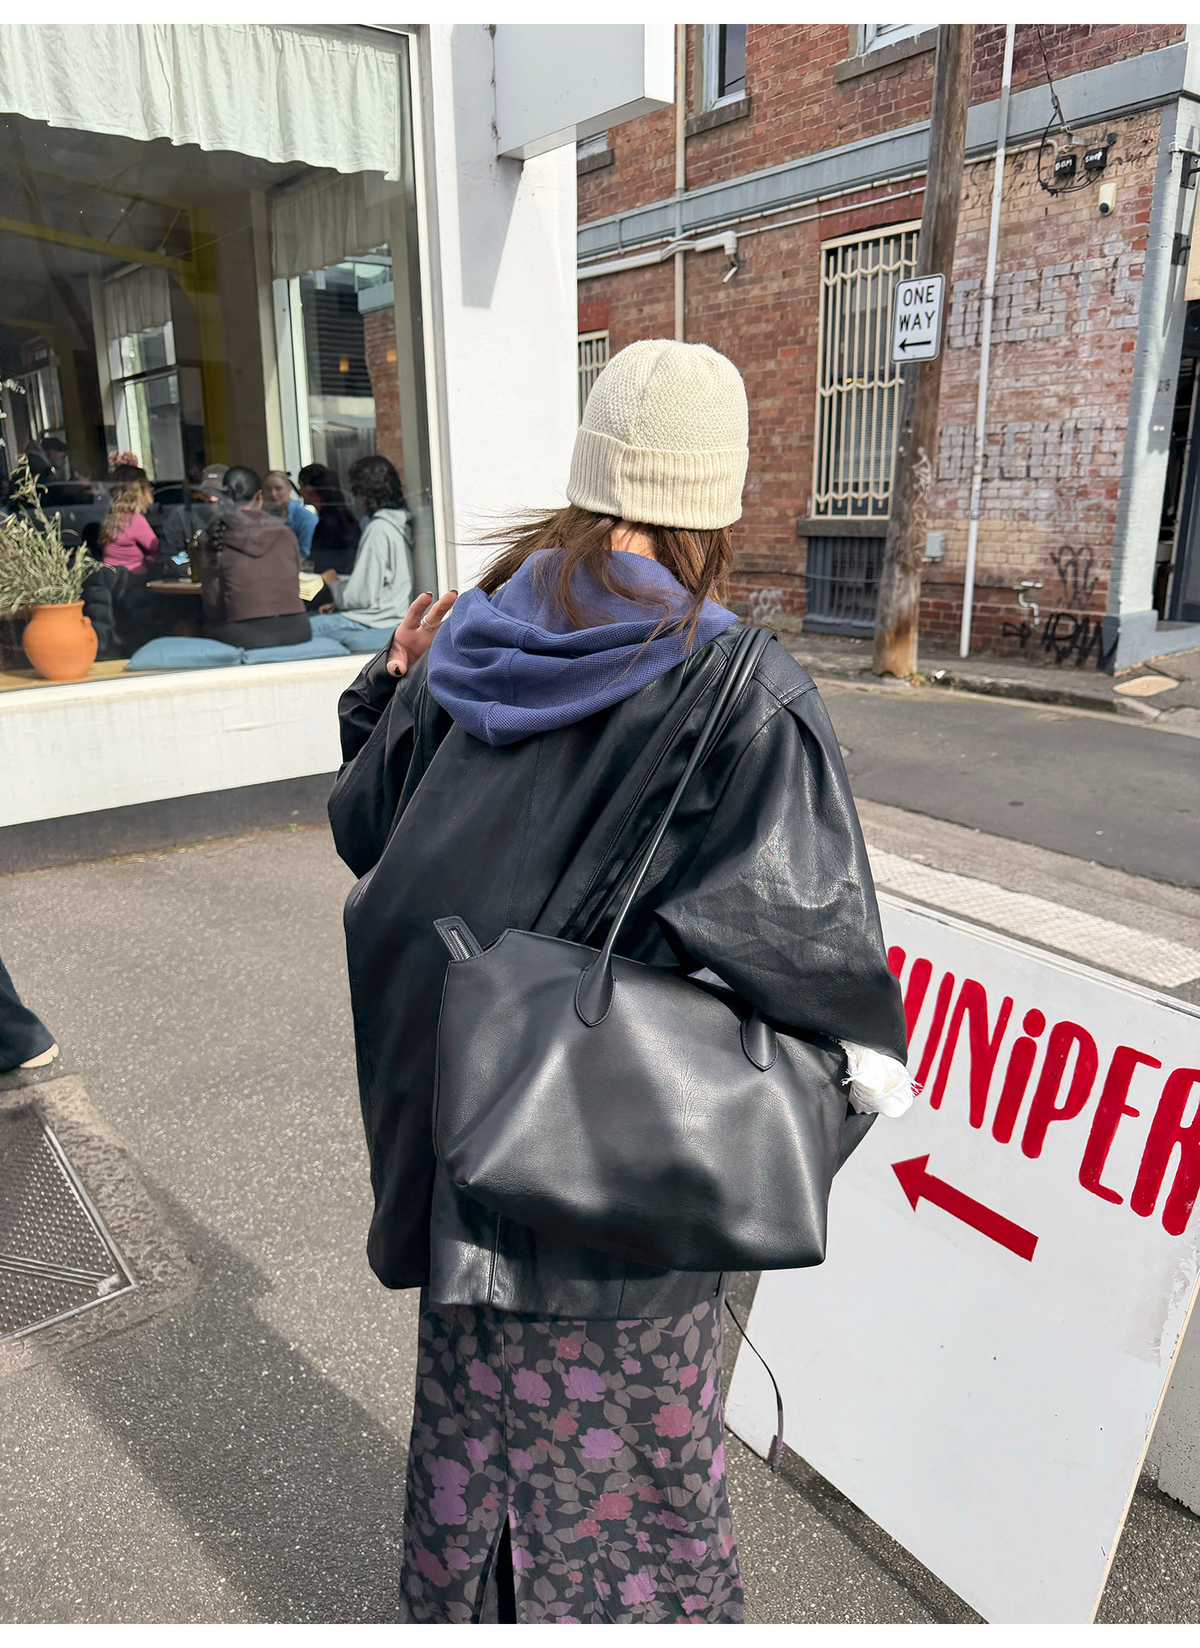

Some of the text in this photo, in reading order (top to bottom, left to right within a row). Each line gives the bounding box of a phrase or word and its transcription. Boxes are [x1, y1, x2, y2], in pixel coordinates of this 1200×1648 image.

[903, 285, 936, 307] ONE
[899, 310, 936, 332] WAY
[887, 945, 1200, 1237] UNiPER
